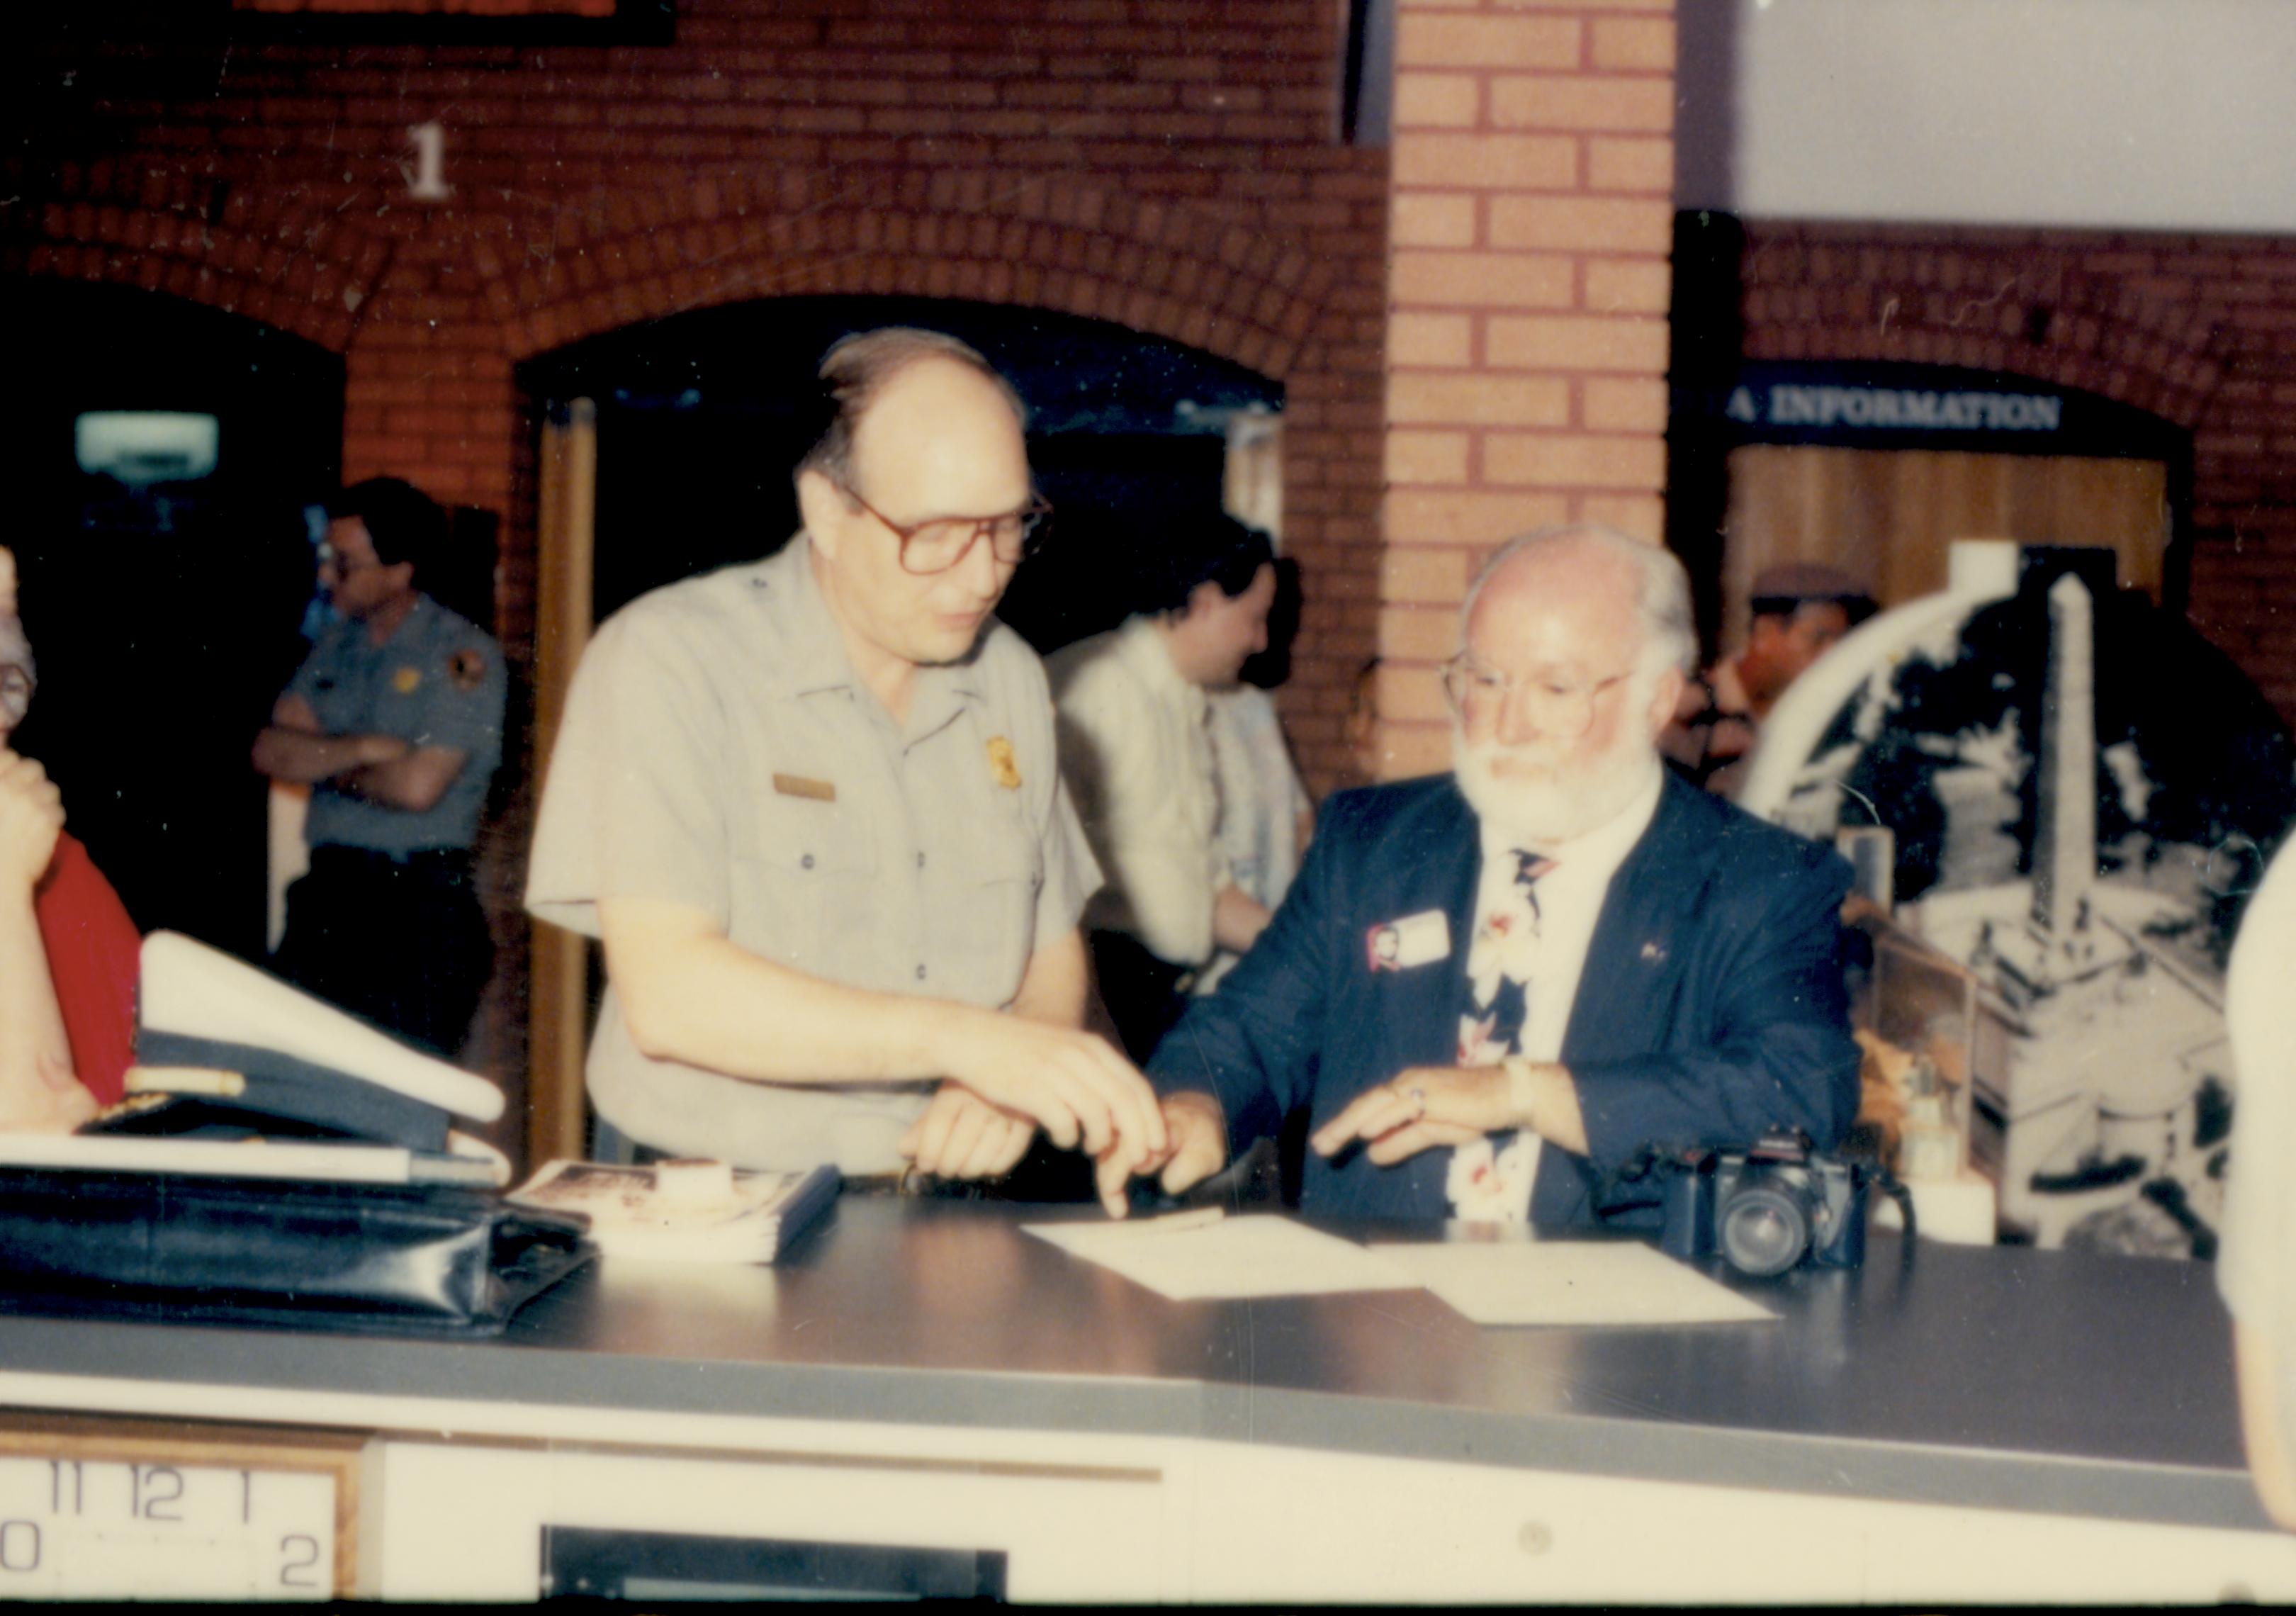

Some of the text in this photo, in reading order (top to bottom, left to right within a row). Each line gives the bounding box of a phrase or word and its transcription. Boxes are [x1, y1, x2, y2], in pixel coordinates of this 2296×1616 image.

[407, 122, 449, 198] 1
[1770, 385, 2059, 430] INFORMATION
[49, 1460, 184, 1520] 11 12
[241, 1470, 250, 1524] 1
[280, 1534, 319, 1587] 2
